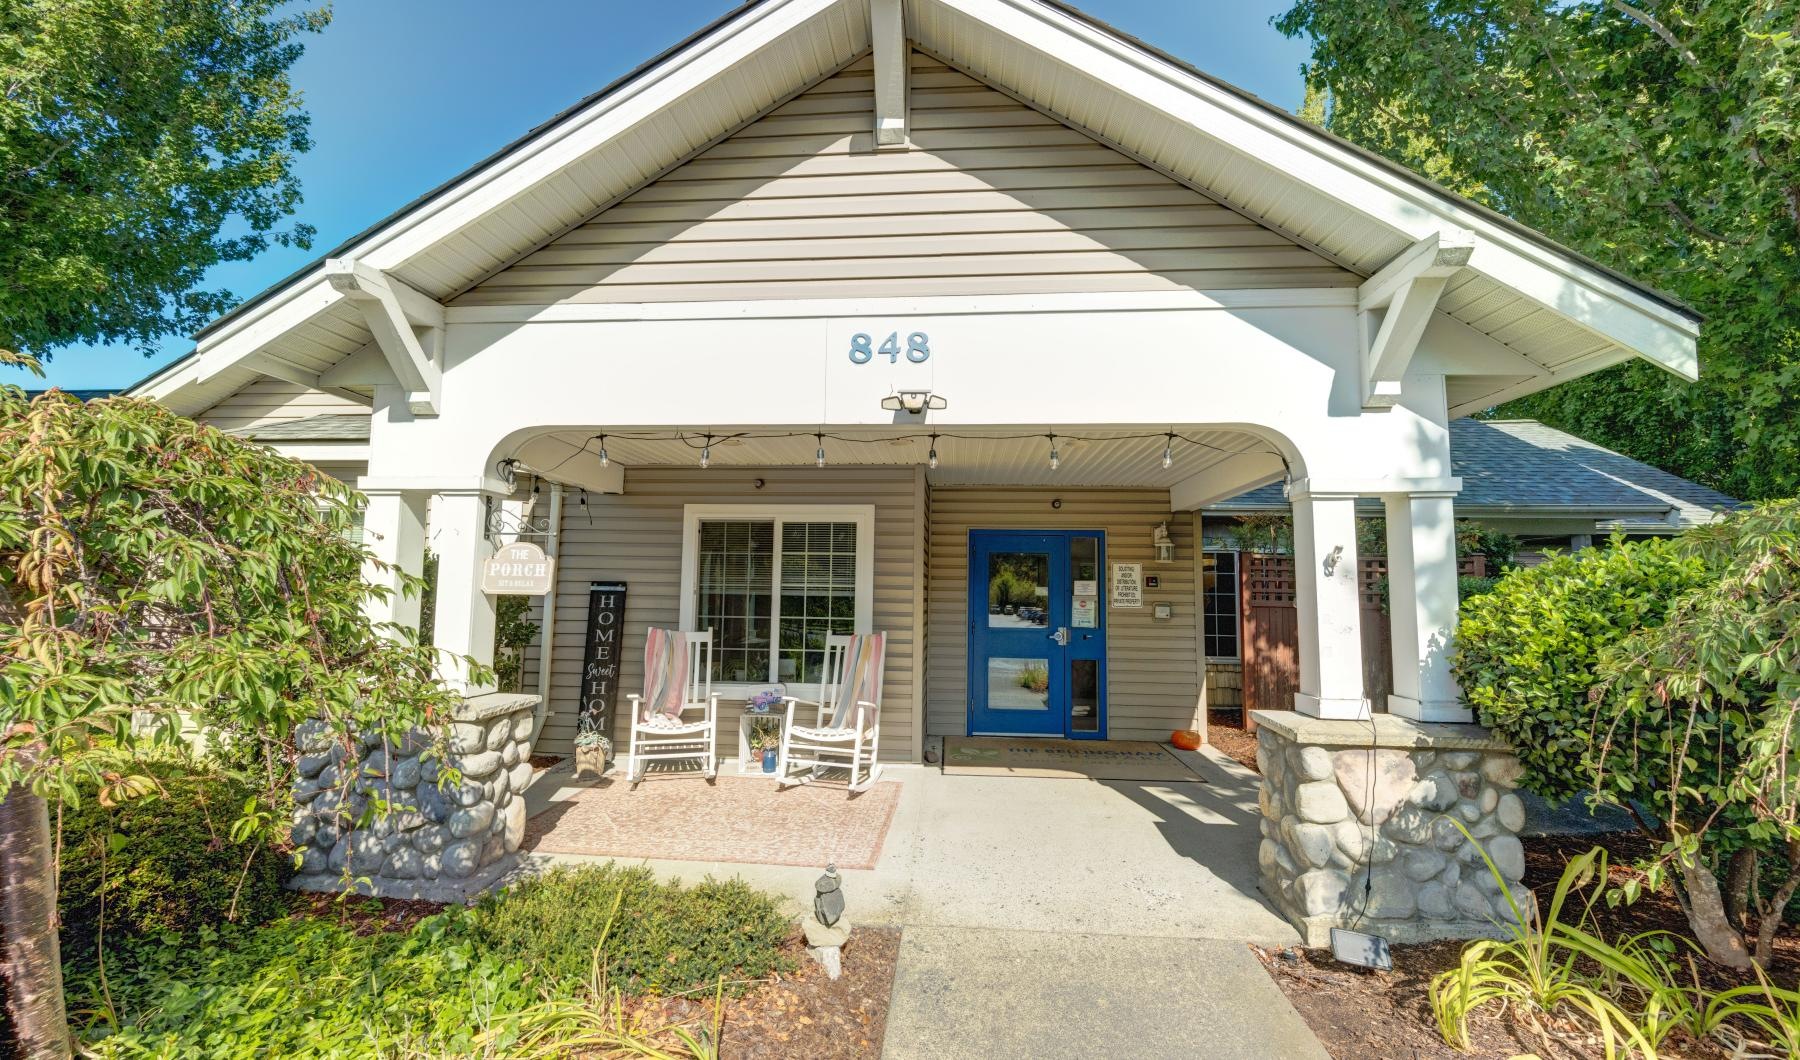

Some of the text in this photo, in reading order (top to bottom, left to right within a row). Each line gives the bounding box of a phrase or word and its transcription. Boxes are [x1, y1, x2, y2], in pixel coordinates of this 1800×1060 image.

[849, 331, 930, 364] 848
[510, 549, 529, 560] THE
[488, 562, 546, 576] PORCH
[594, 595, 615, 660] HOME
[586, 662, 617, 680] Sweet
[588, 682, 608, 731] HOM
